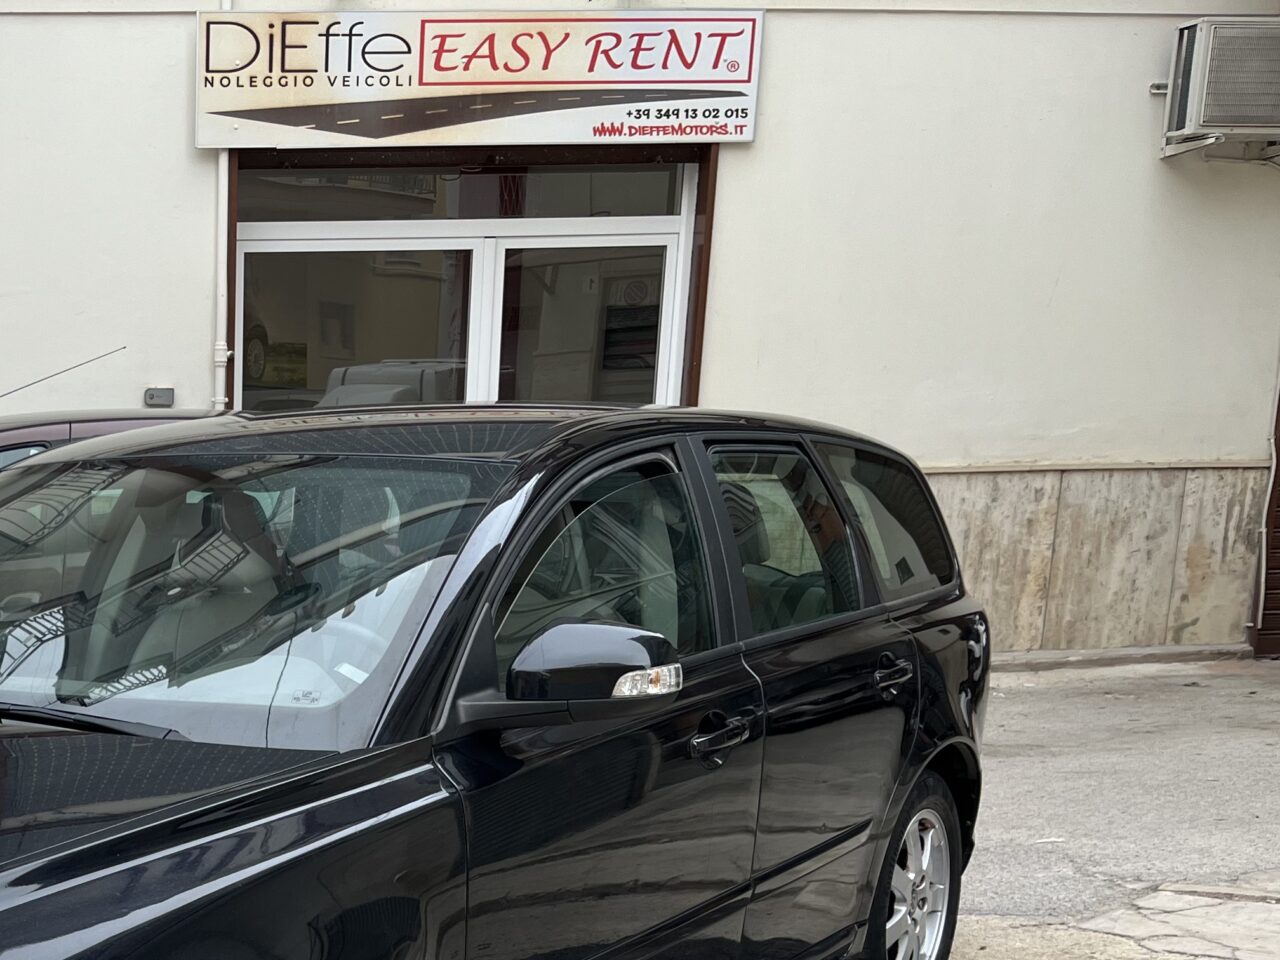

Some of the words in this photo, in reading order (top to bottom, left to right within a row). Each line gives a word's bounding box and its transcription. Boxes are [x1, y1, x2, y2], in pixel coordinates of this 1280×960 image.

[205, 21, 412, 73] DiEffe
[431, 31, 570, 73] EASY
[204, 76, 314, 87] NOLEGGIO
[327, 75, 412, 87] VEICOLI
[626, 108, 650, 119] +39
[654, 108, 679, 119] 349
[684, 109, 698, 119] 13
[702, 108, 720, 119] 02
[724, 108, 748, 119] 015
